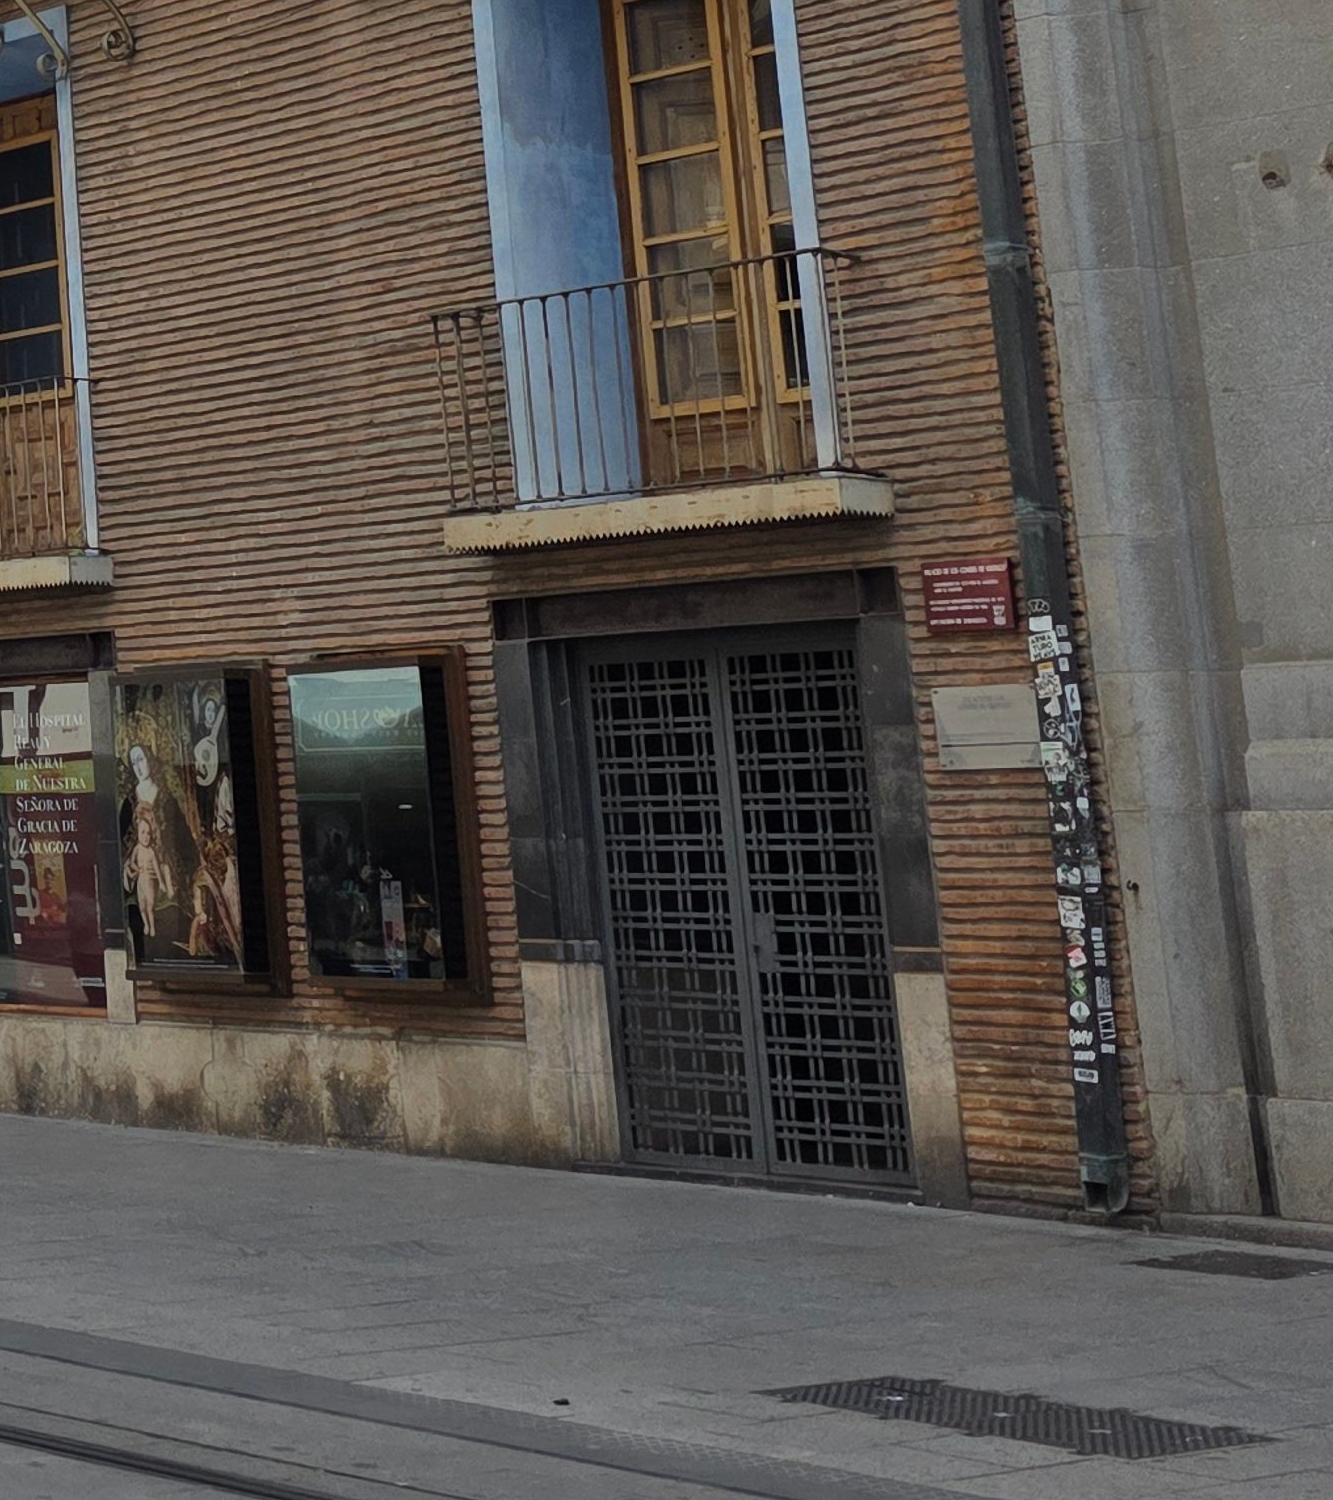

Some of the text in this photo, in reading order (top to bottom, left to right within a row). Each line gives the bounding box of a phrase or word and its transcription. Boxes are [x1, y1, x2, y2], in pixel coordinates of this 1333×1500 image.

[30, 712, 85, 729] HOSPITAL
[14, 756, 65, 771] GENERAL
[16, 775, 87, 791] DE NUESTRA
[16, 796, 79, 813] SEÑORA DE
[17, 817, 78, 833] GRACIA DE
[19, 837, 79, 854] ZARAGOZA
